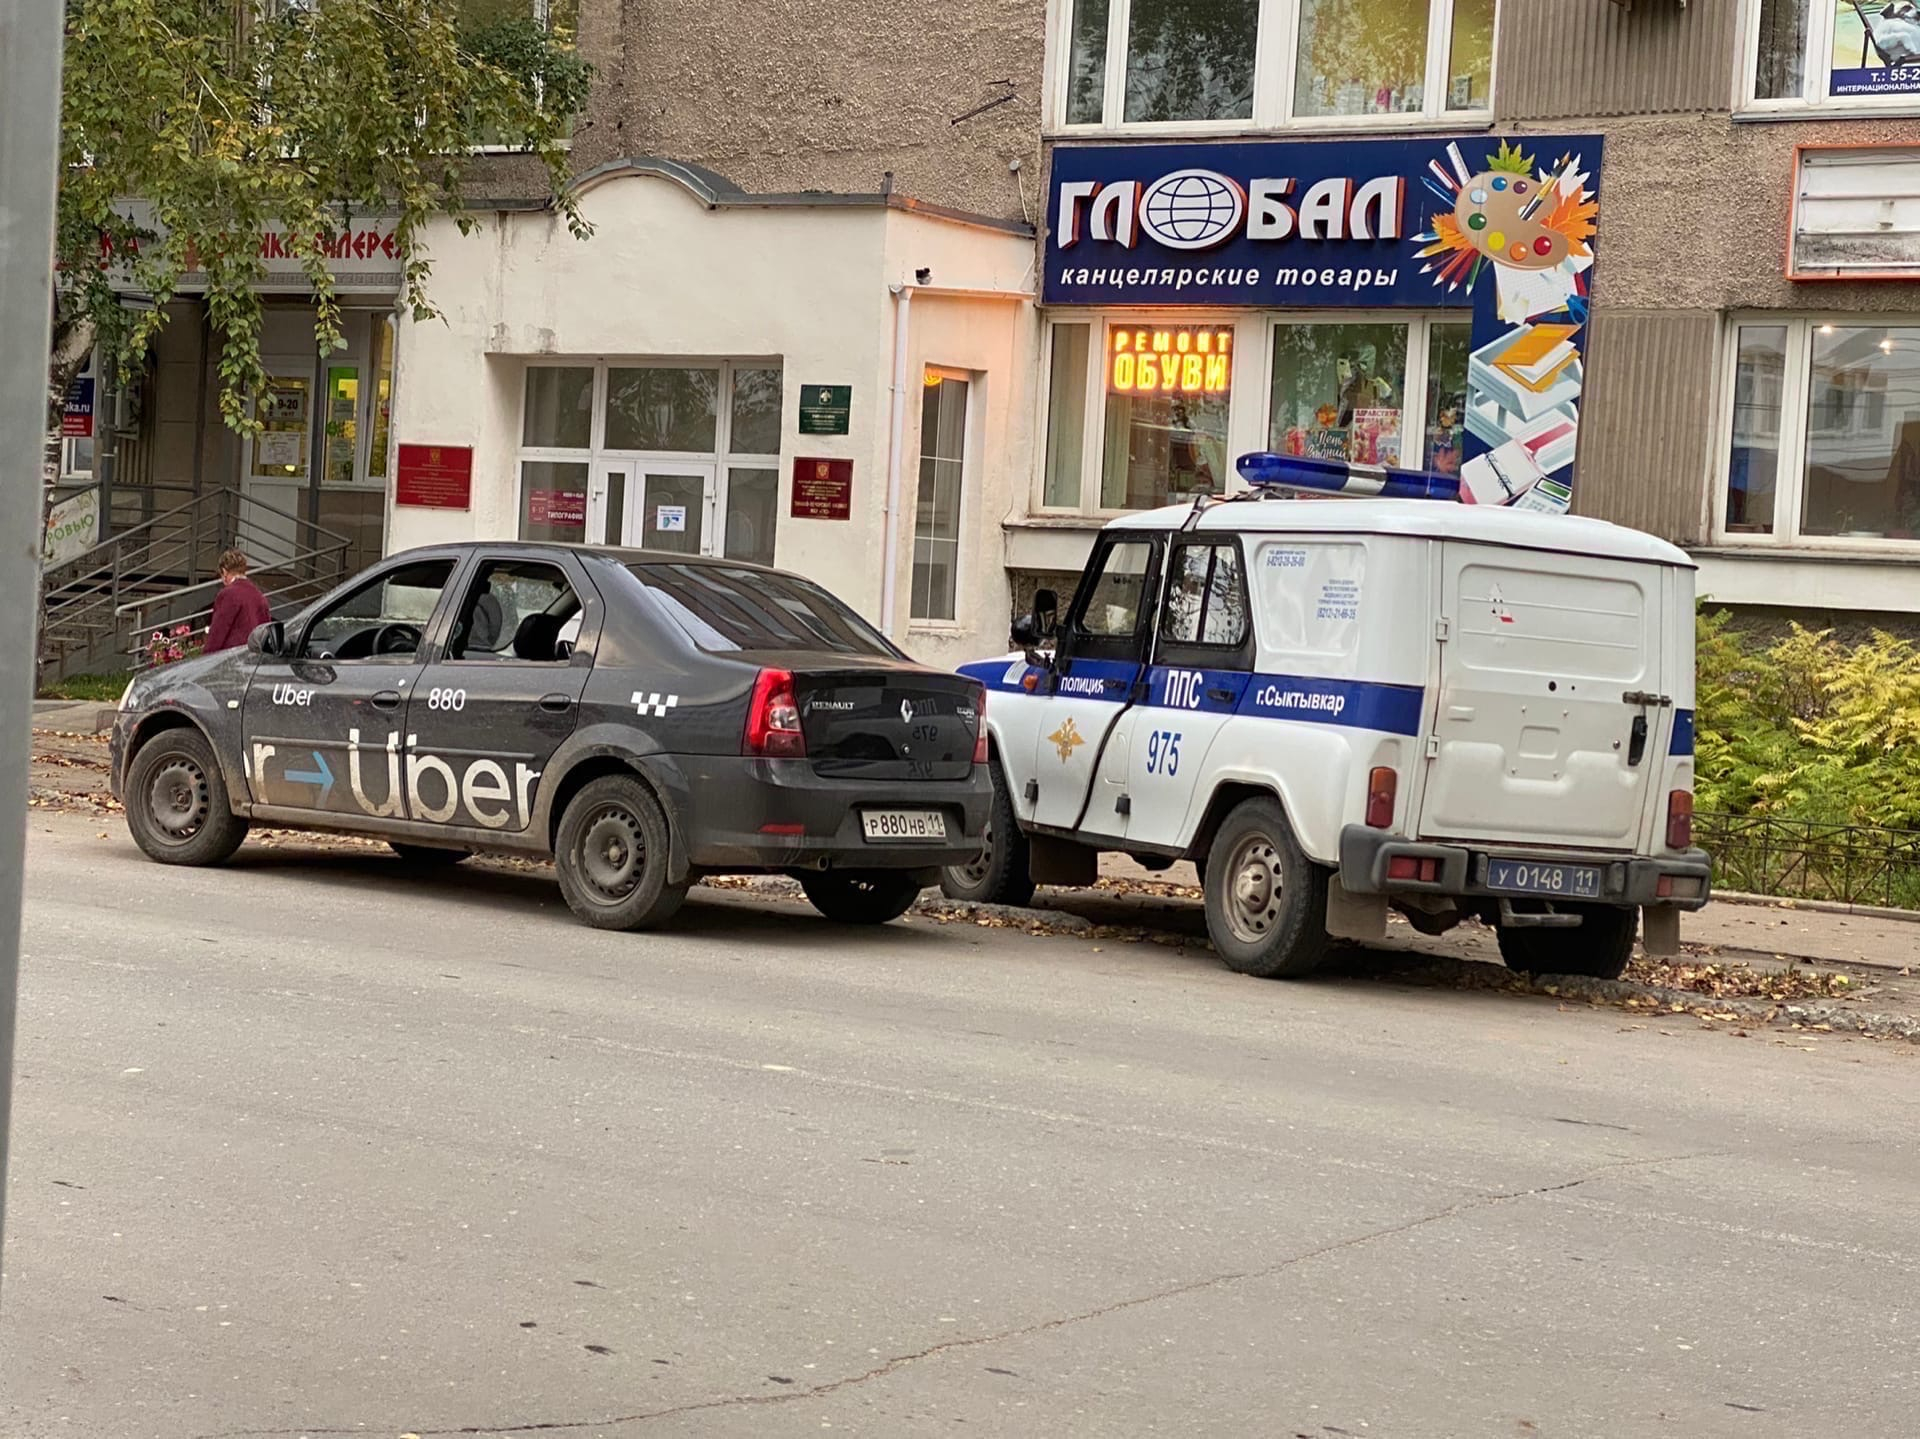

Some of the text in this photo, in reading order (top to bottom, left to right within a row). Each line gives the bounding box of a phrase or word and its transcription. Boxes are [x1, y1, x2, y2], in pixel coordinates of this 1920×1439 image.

[1058, 169, 1404, 249] ГЛОБАЛ
[1060, 266, 1398, 291] канцелярские товары
[1115, 331, 1230, 353] РЕМОНТ
[1114, 353, 1227, 390] ОБУВИ
[47, 513, 94, 545] РОВЬЮ
[428, 687, 466, 711] 880
[1163, 669, 1204, 709] ППС
[1256, 685, 1345, 716] г.Сыктывкар
[811, 700, 856, 710] RENAULT
[1147, 730, 1182, 776] 975
[349, 728, 541, 829] Uber
[1516, 865, 1563, 890] 0148
[1576, 869, 1594, 887] 11
